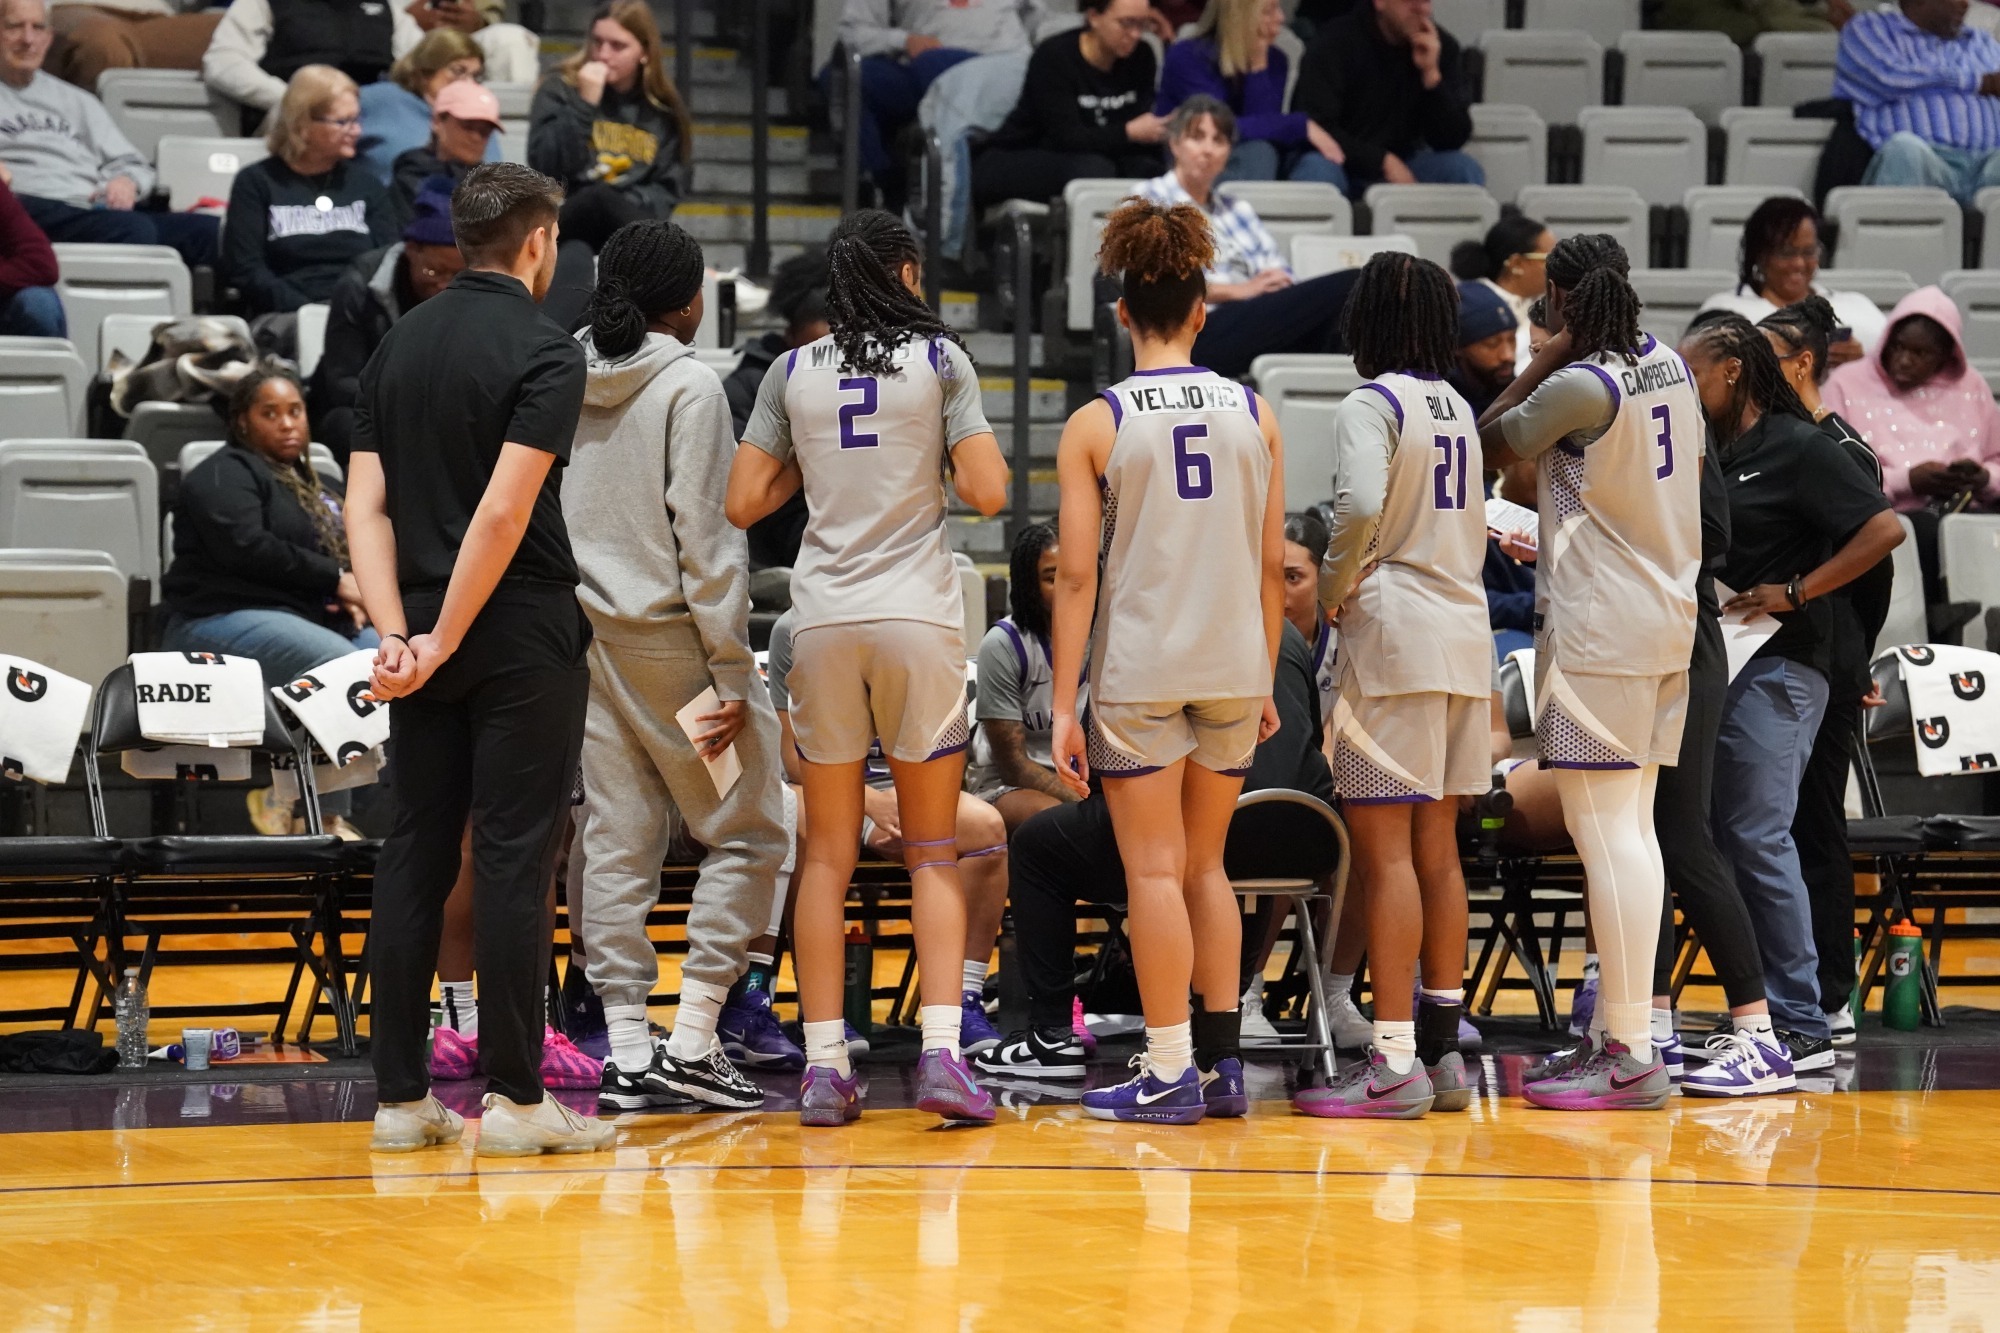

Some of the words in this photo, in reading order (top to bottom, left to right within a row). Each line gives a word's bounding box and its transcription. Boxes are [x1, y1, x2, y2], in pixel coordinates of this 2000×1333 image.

[838, 376, 879, 450] 2
[1130, 385, 1238, 412] VELJOVIC
[1425, 396, 1457, 421] BILA
[1621, 359, 1685, 396] CAMPBELL
[1171, 423, 1214, 501] 6
[1433, 434, 1466, 511] 21
[1651, 403, 1674, 482] 3
